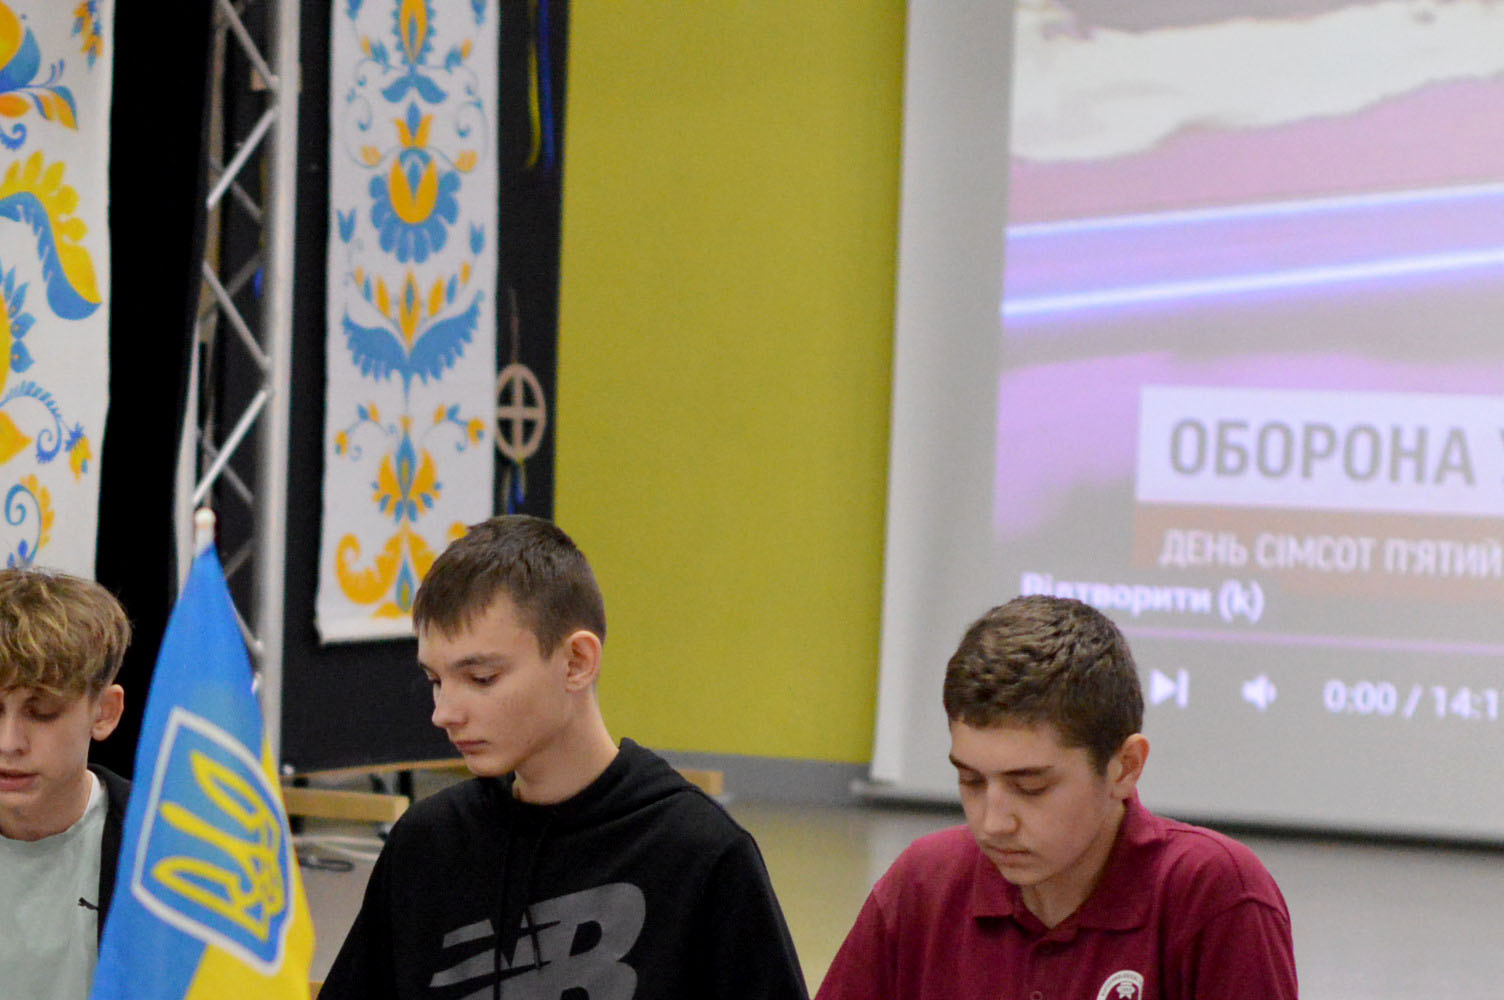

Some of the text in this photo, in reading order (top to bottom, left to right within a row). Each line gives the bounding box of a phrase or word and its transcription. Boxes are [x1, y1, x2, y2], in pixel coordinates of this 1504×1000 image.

[1169, 417, 1477, 487] ОБОРОНА
[1158, 528, 1247, 567] ДЕНЬ
[1255, 532, 1376, 573] СІМСОТ
[1323, 679, 1397, 716] 0:00
